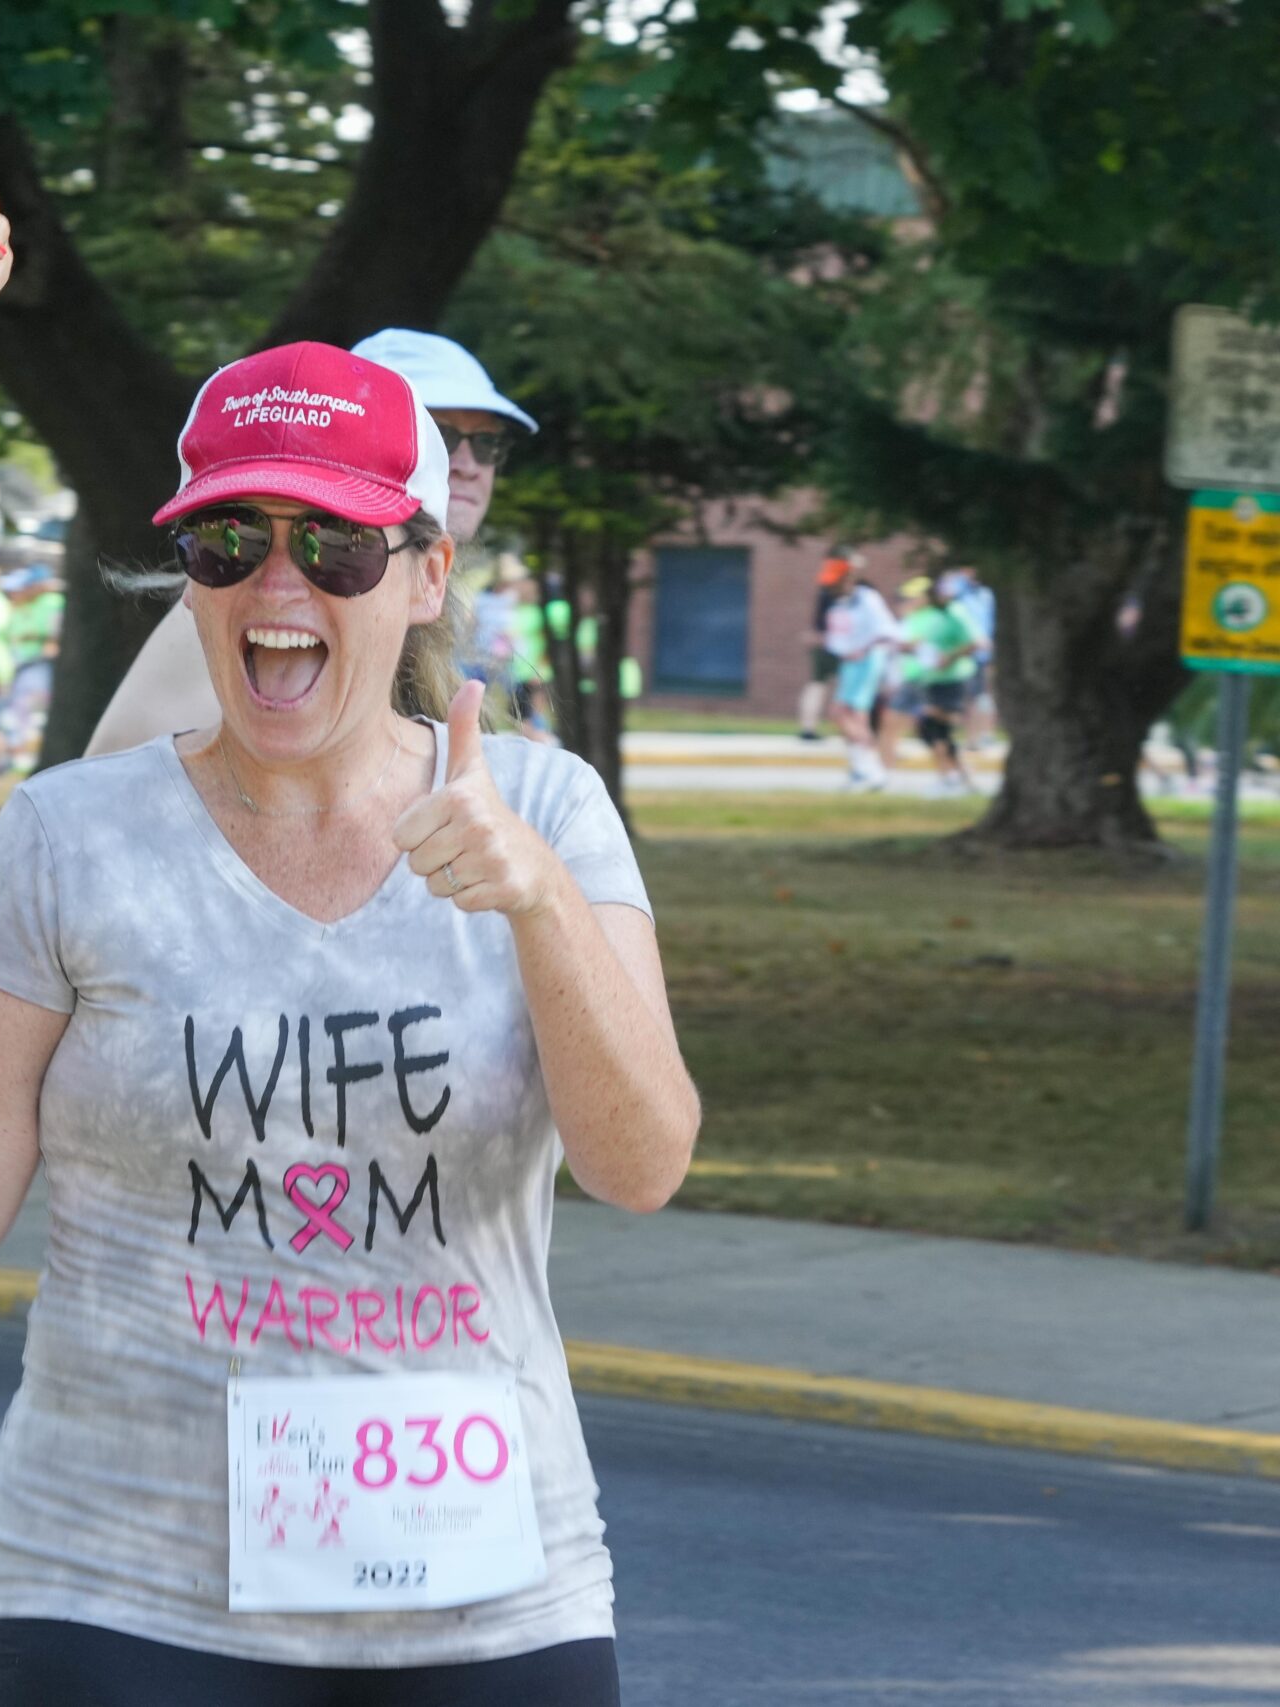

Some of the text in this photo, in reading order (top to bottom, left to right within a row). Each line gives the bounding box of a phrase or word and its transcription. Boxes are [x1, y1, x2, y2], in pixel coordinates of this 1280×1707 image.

[221, 386, 365, 416] Town of Southampton
[234, 406, 331, 428] LIFEGUARD
[184, 1004, 451, 1147] WIFE
[186, 1271, 490, 1352] WARRIOR
[308, 1446, 345, 1475] Run
[352, 1412, 509, 1490] 830
[352, 1560, 428, 1588] 2022
